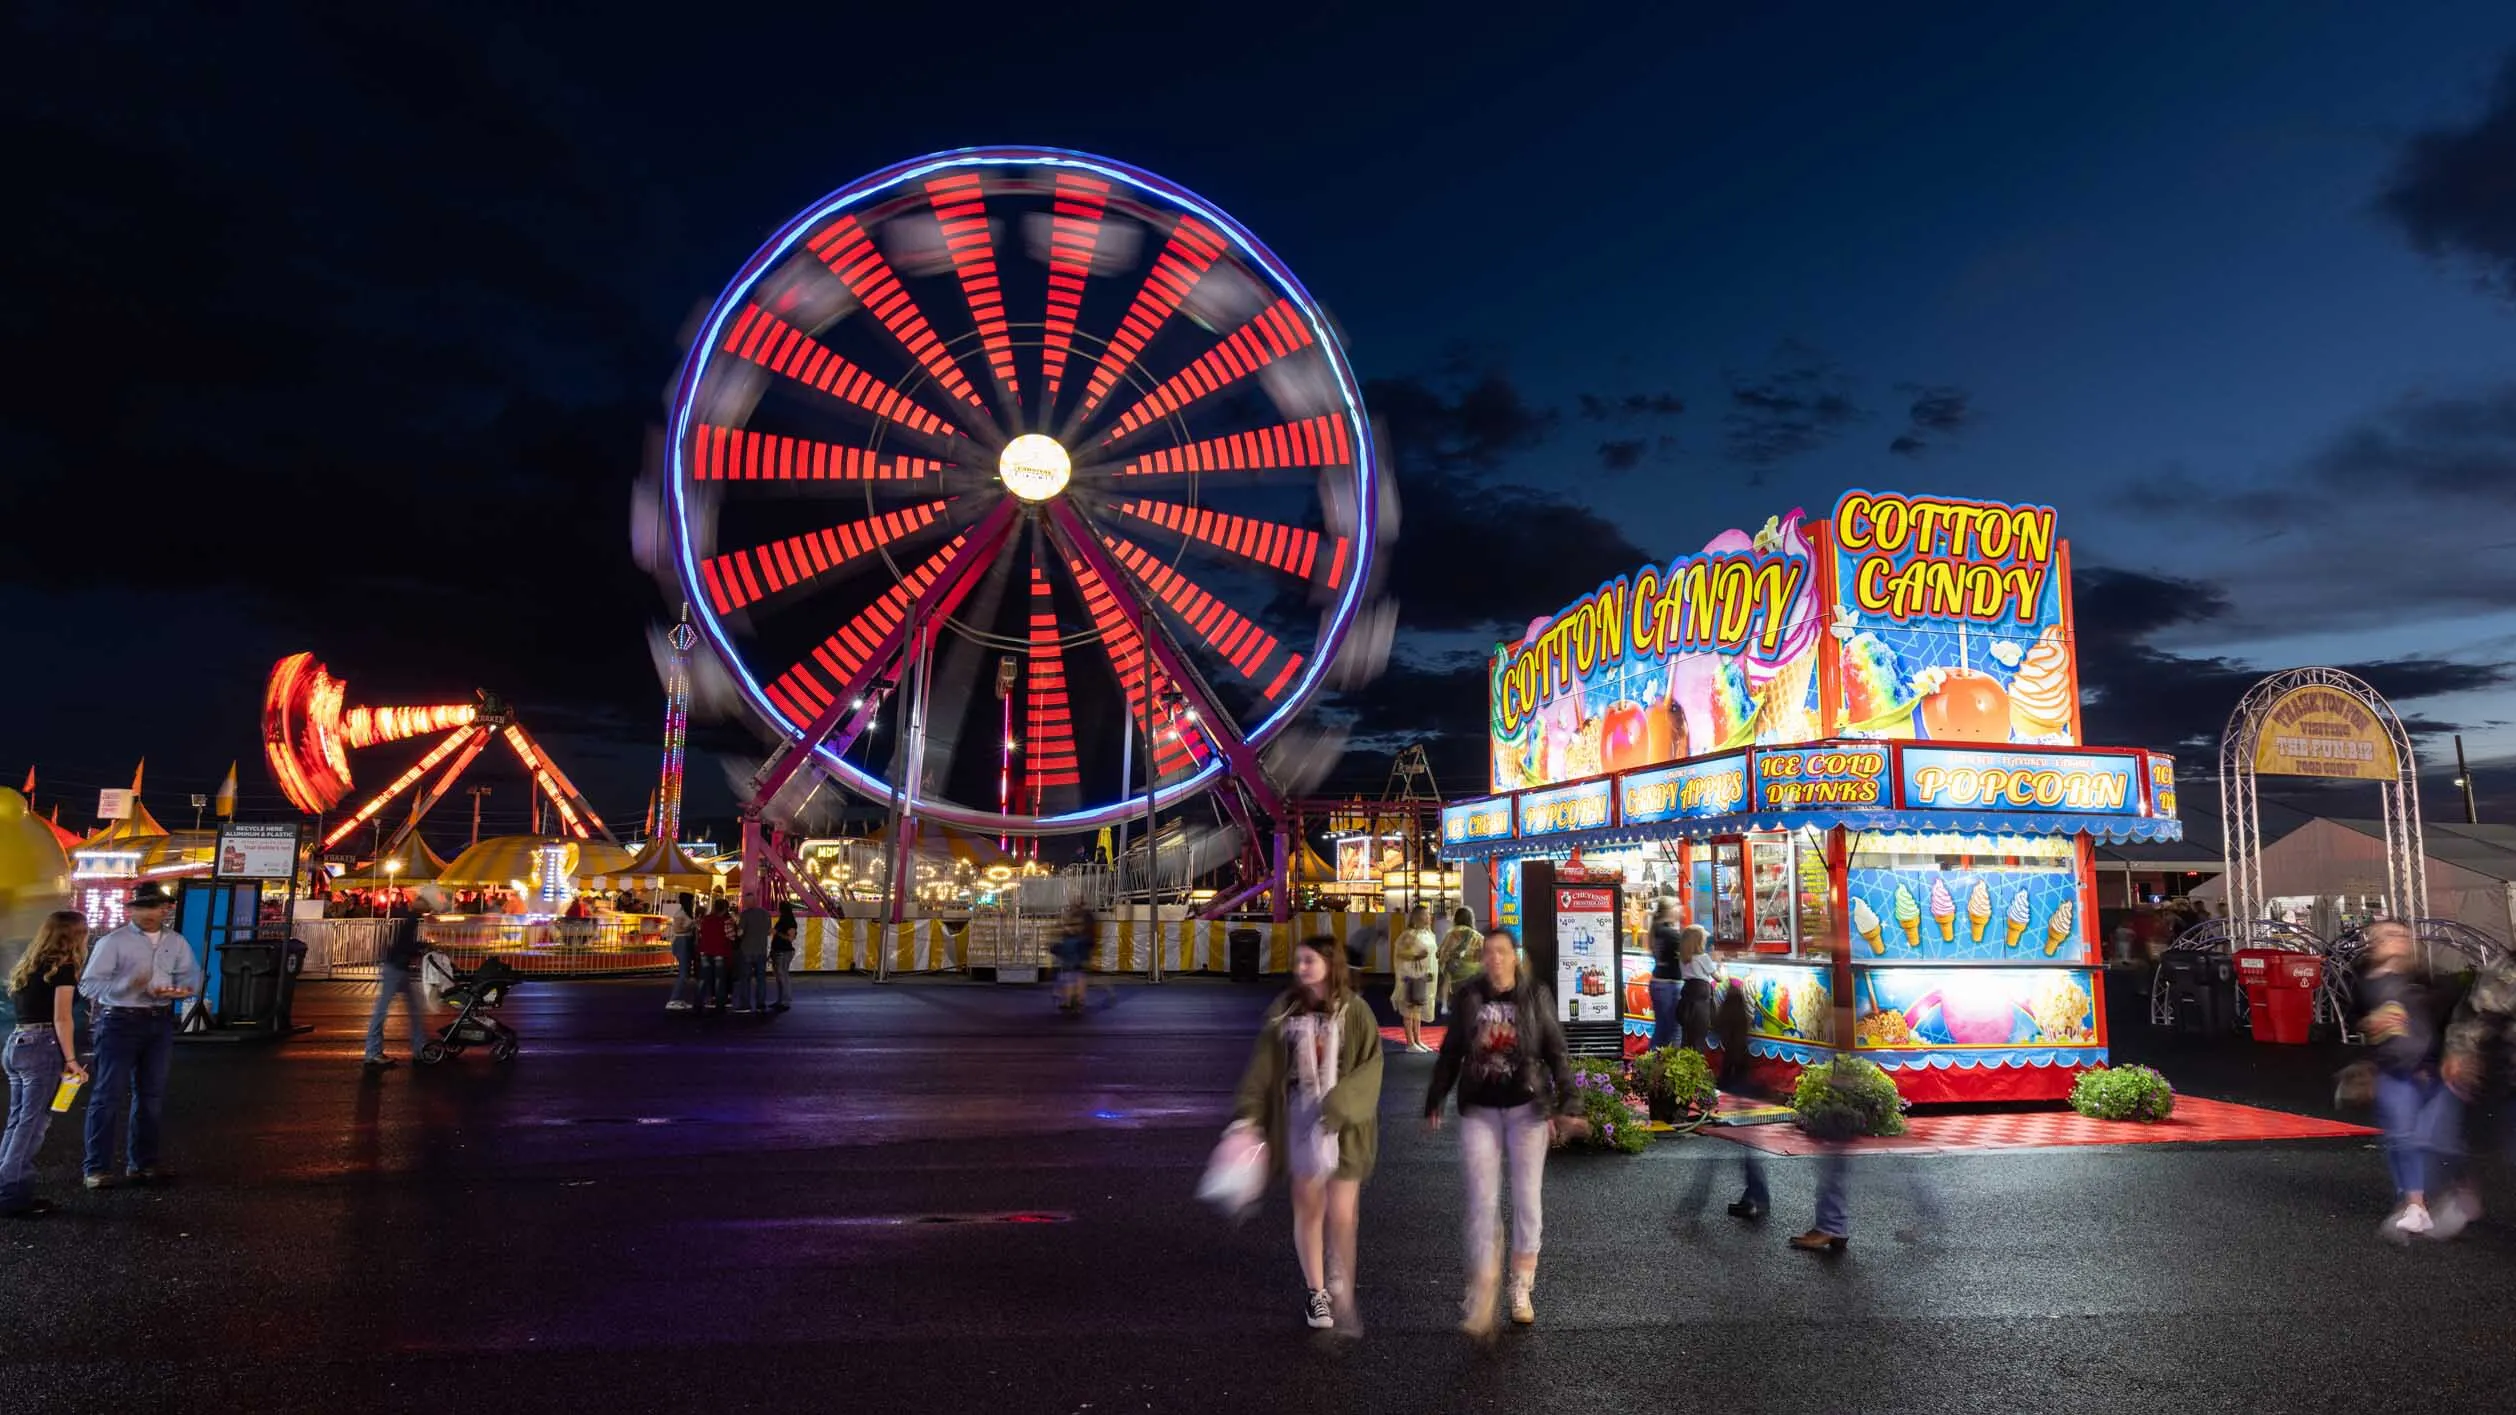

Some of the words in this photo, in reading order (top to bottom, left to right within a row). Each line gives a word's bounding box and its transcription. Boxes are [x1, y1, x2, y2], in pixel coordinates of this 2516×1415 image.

[1838, 496, 2053, 563] COTTON
[1857, 556, 2042, 619] CANDY
[1501, 585, 1625, 731] COTTON
[1631, 560, 1799, 656] CANDY
[1760, 756, 1801, 778] ICE
[1806, 754, 1882, 780] COLD
[1914, 766, 2128, 808] POPCORN
[1625, 781, 1679, 815] CANDY
[1681, 768, 1744, 812] APPLES
[1765, 780, 1879, 804] DRINKS
[1525, 793, 1608, 833] POPCORN
[1572, 891, 1611, 902] CHEYENNE
